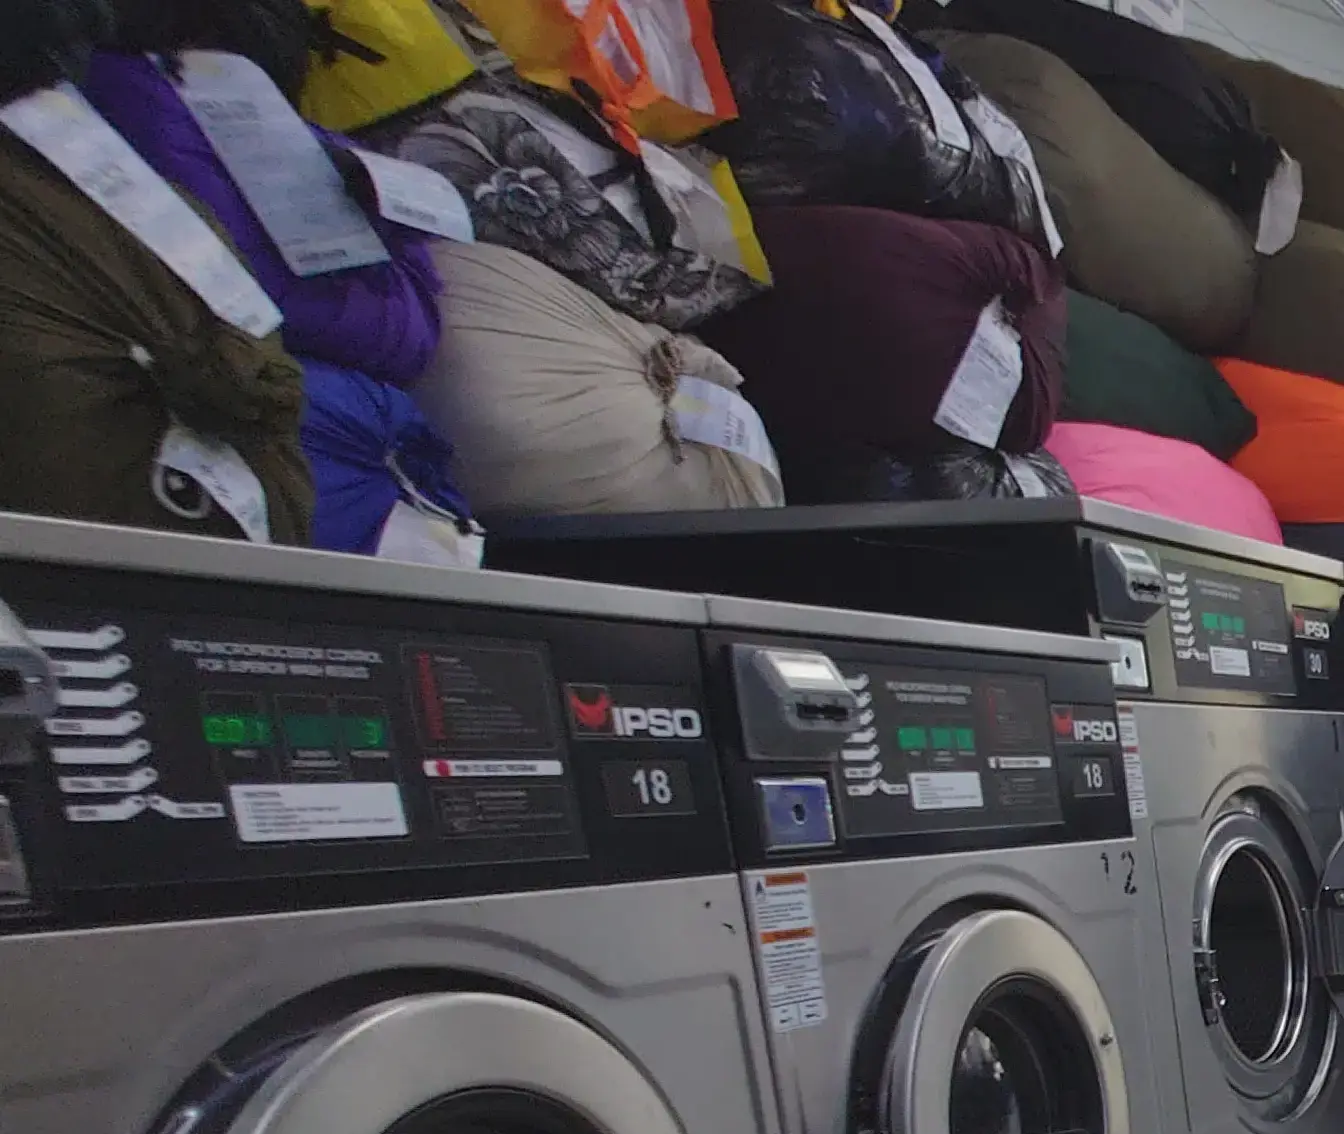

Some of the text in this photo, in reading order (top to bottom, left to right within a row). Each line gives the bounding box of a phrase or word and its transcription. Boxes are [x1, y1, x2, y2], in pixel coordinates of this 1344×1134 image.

[1309, 653, 1323, 674] 30
[612, 707, 702, 738] IPSO
[1073, 720, 1118, 741] IPSO
[632, 769, 672, 804] 18
[1083, 763, 1103, 788] 18
[1100, 850, 1138, 895] 12
